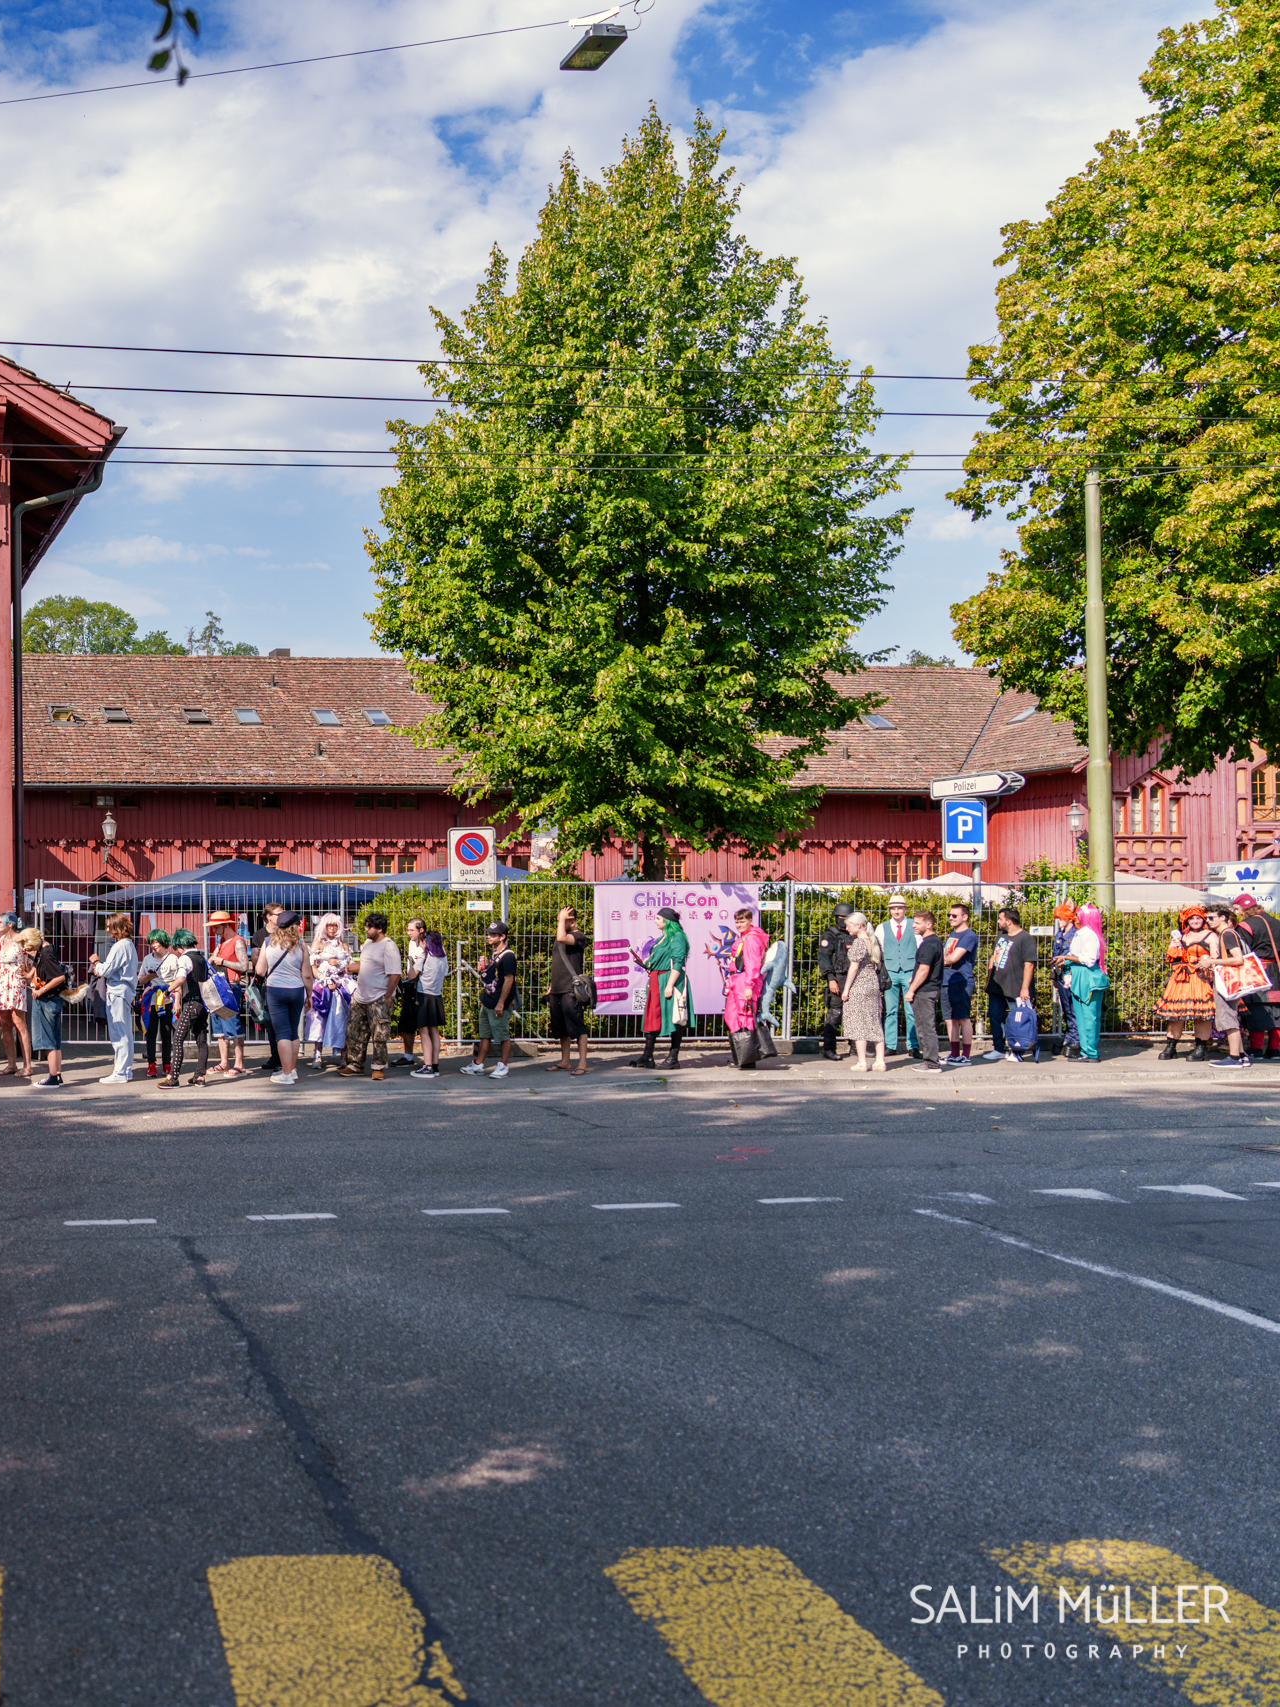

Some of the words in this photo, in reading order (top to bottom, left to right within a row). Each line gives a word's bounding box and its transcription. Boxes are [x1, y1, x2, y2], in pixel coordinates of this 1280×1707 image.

[954, 780, 977, 791] Polizei
[958, 815, 973, 839] P
[460, 869, 485, 877] ganzes
[633, 891, 718, 907] Chibi-Con
[599, 967, 625, 975] Gaming
[599, 980, 627, 988] Cosplay
